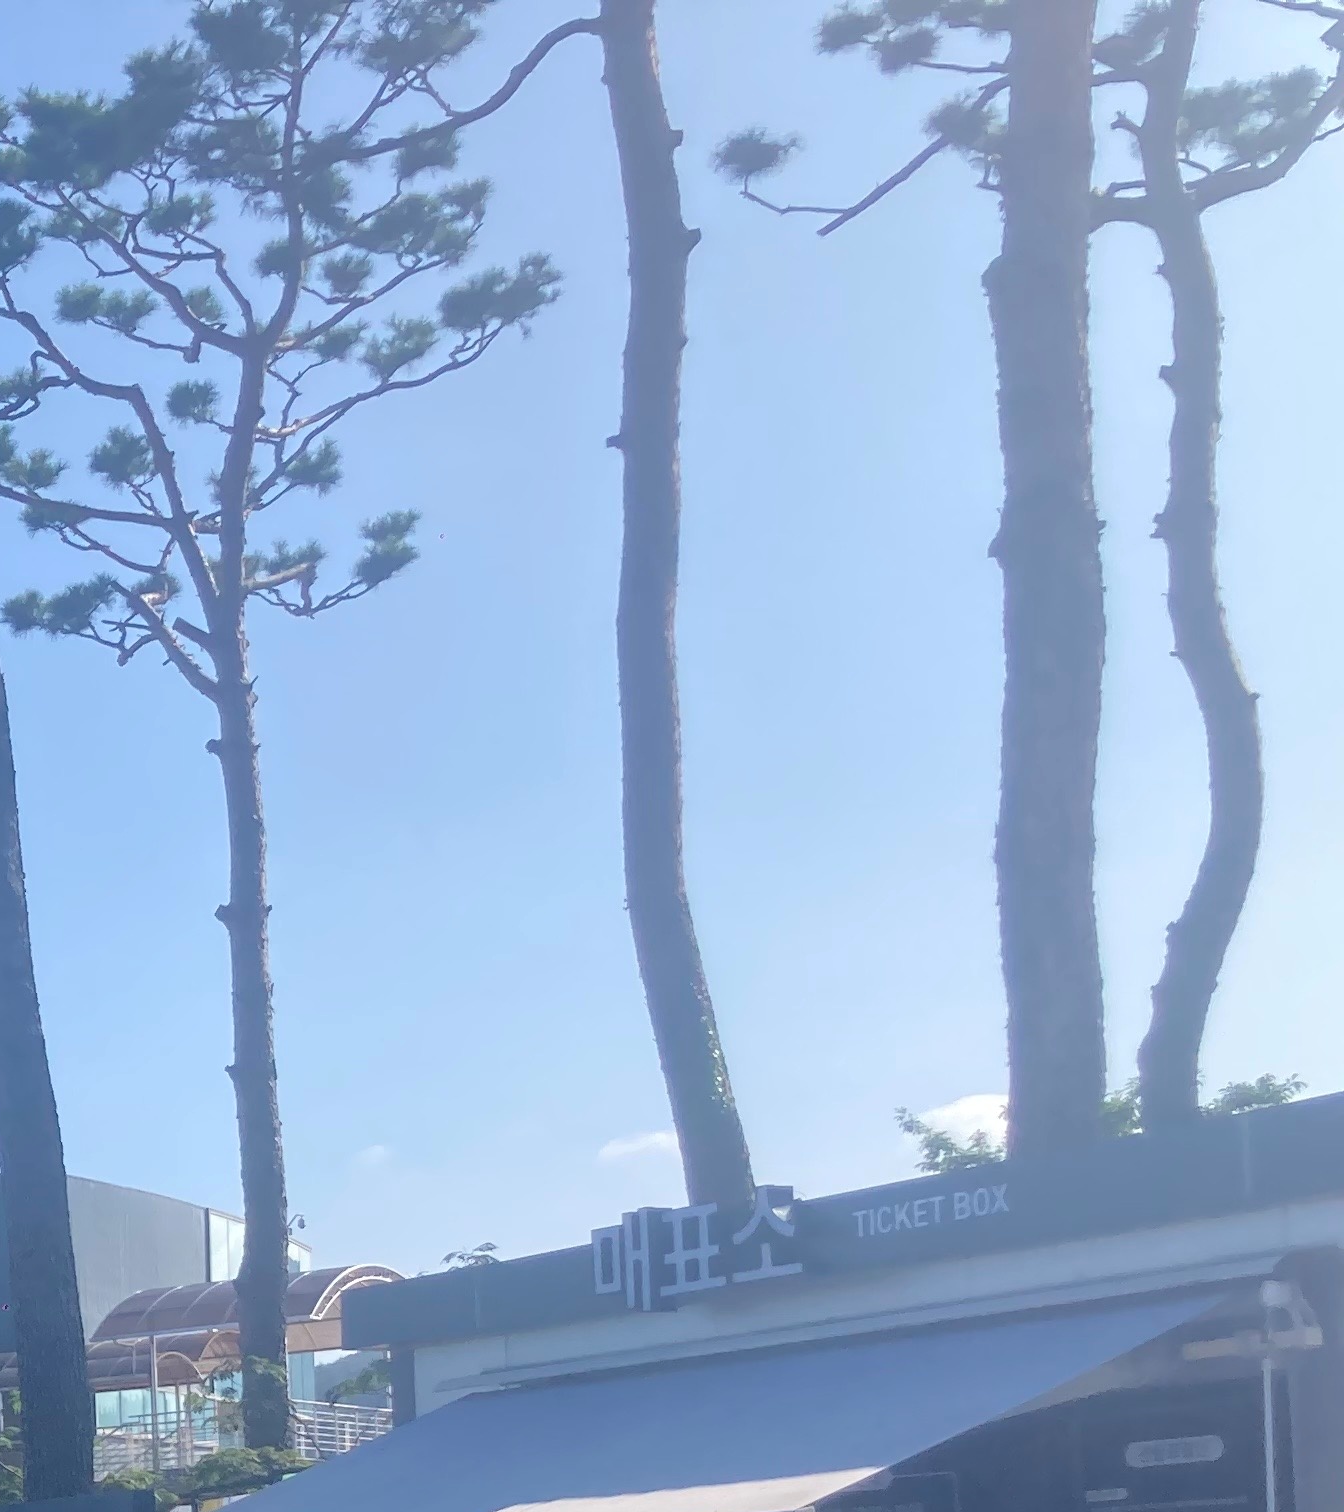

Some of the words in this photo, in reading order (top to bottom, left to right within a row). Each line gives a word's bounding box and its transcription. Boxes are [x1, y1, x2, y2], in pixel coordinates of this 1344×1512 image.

[591, 1184, 803, 1312] 매표소
[852, 1196, 946, 1237] TICKET
[953, 1183, 1010, 1221] BOX
